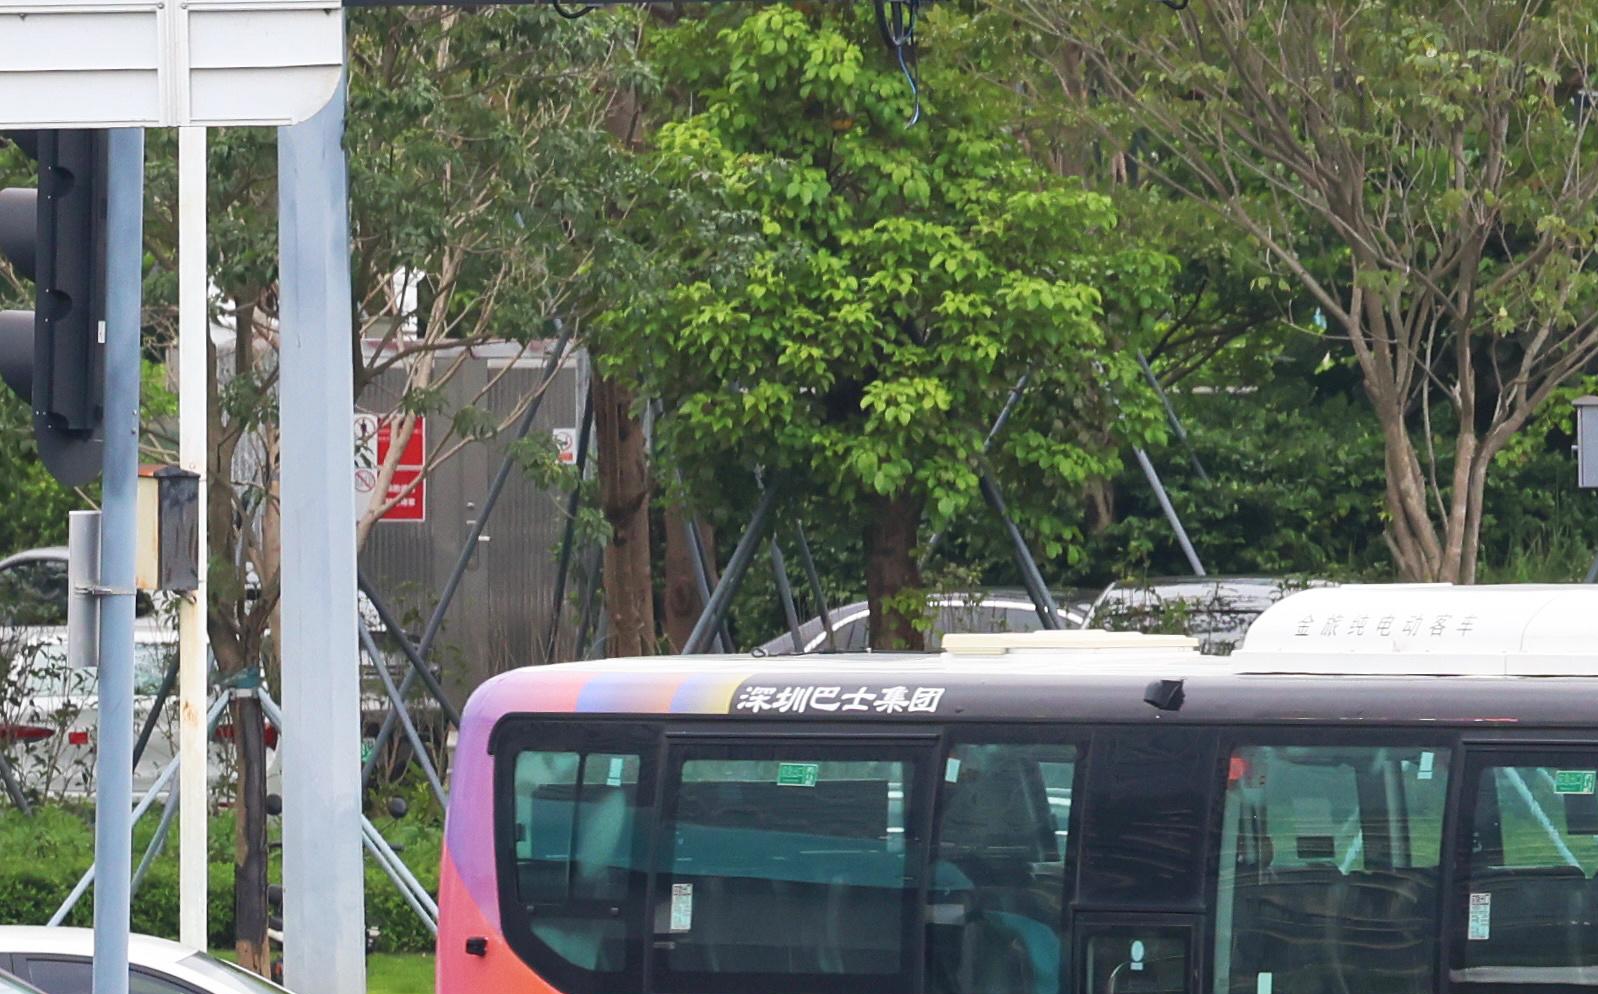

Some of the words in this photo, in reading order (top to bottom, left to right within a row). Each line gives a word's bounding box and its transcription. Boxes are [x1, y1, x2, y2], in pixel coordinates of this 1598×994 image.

[1294, 613, 1480, 638] 金旅纯电动客车
[736, 684, 945, 714] 深圳巴士集团
